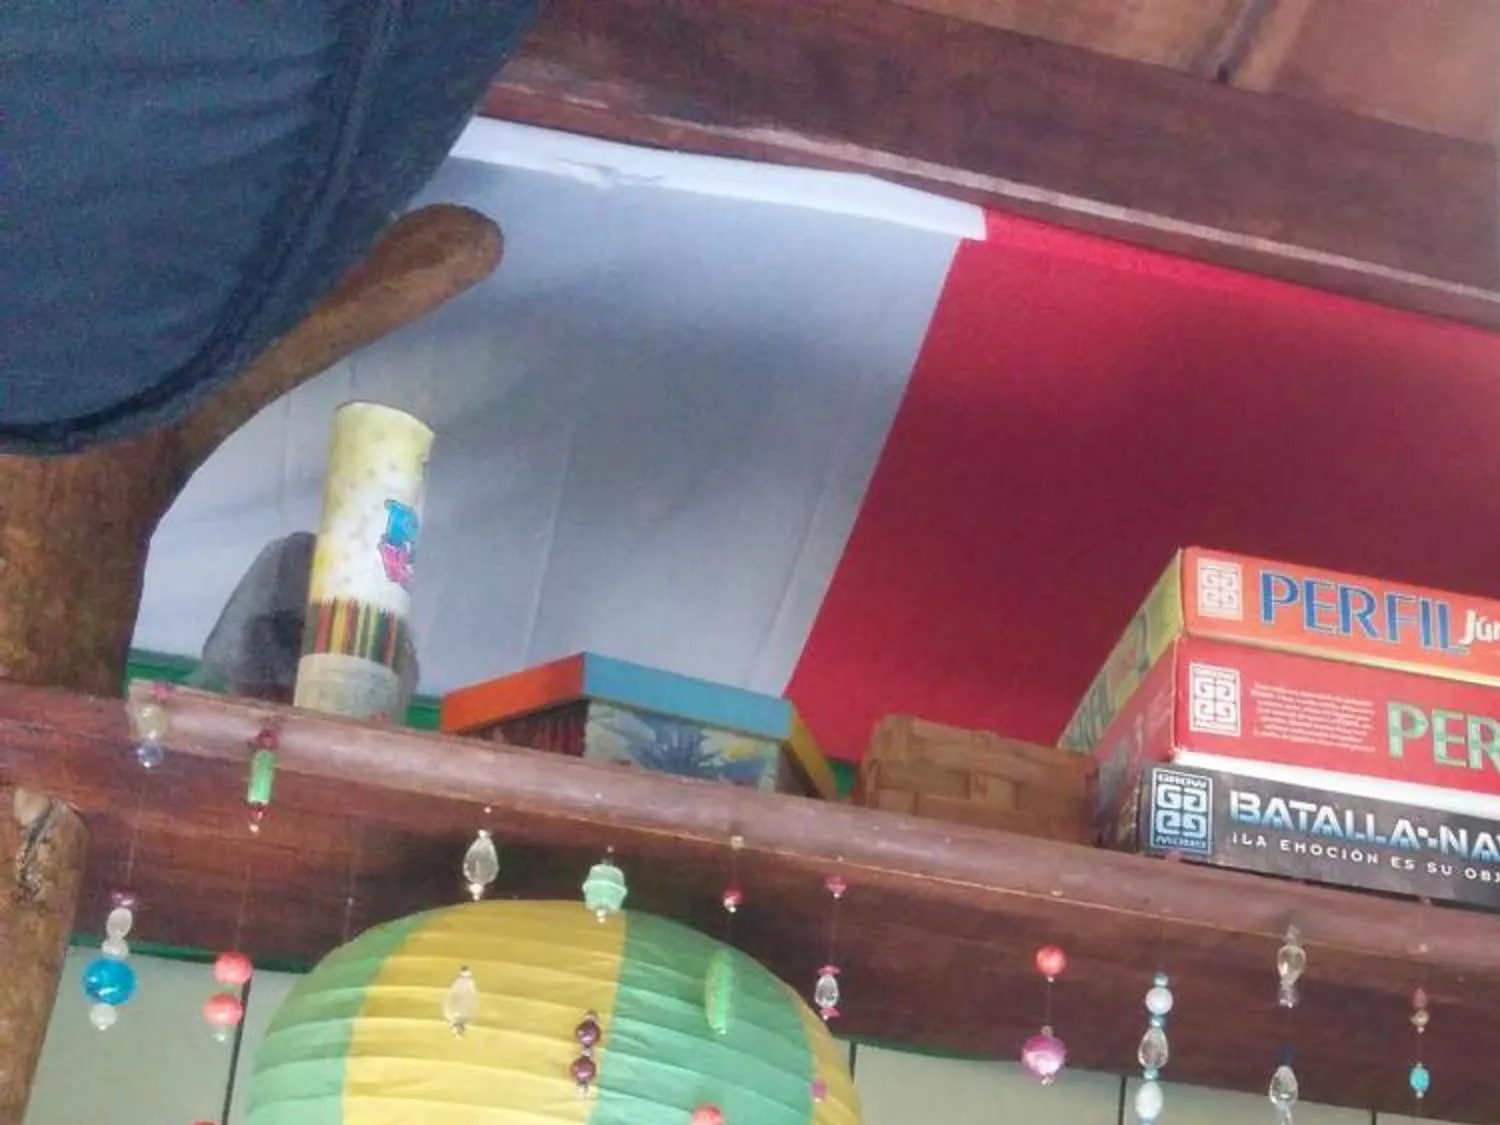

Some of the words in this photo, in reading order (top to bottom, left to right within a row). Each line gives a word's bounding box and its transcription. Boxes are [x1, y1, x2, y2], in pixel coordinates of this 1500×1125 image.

[1259, 568, 1470, 656] PERFIL
[1391, 856, 1416, 871] ES
[1427, 861, 1453, 876] SU
